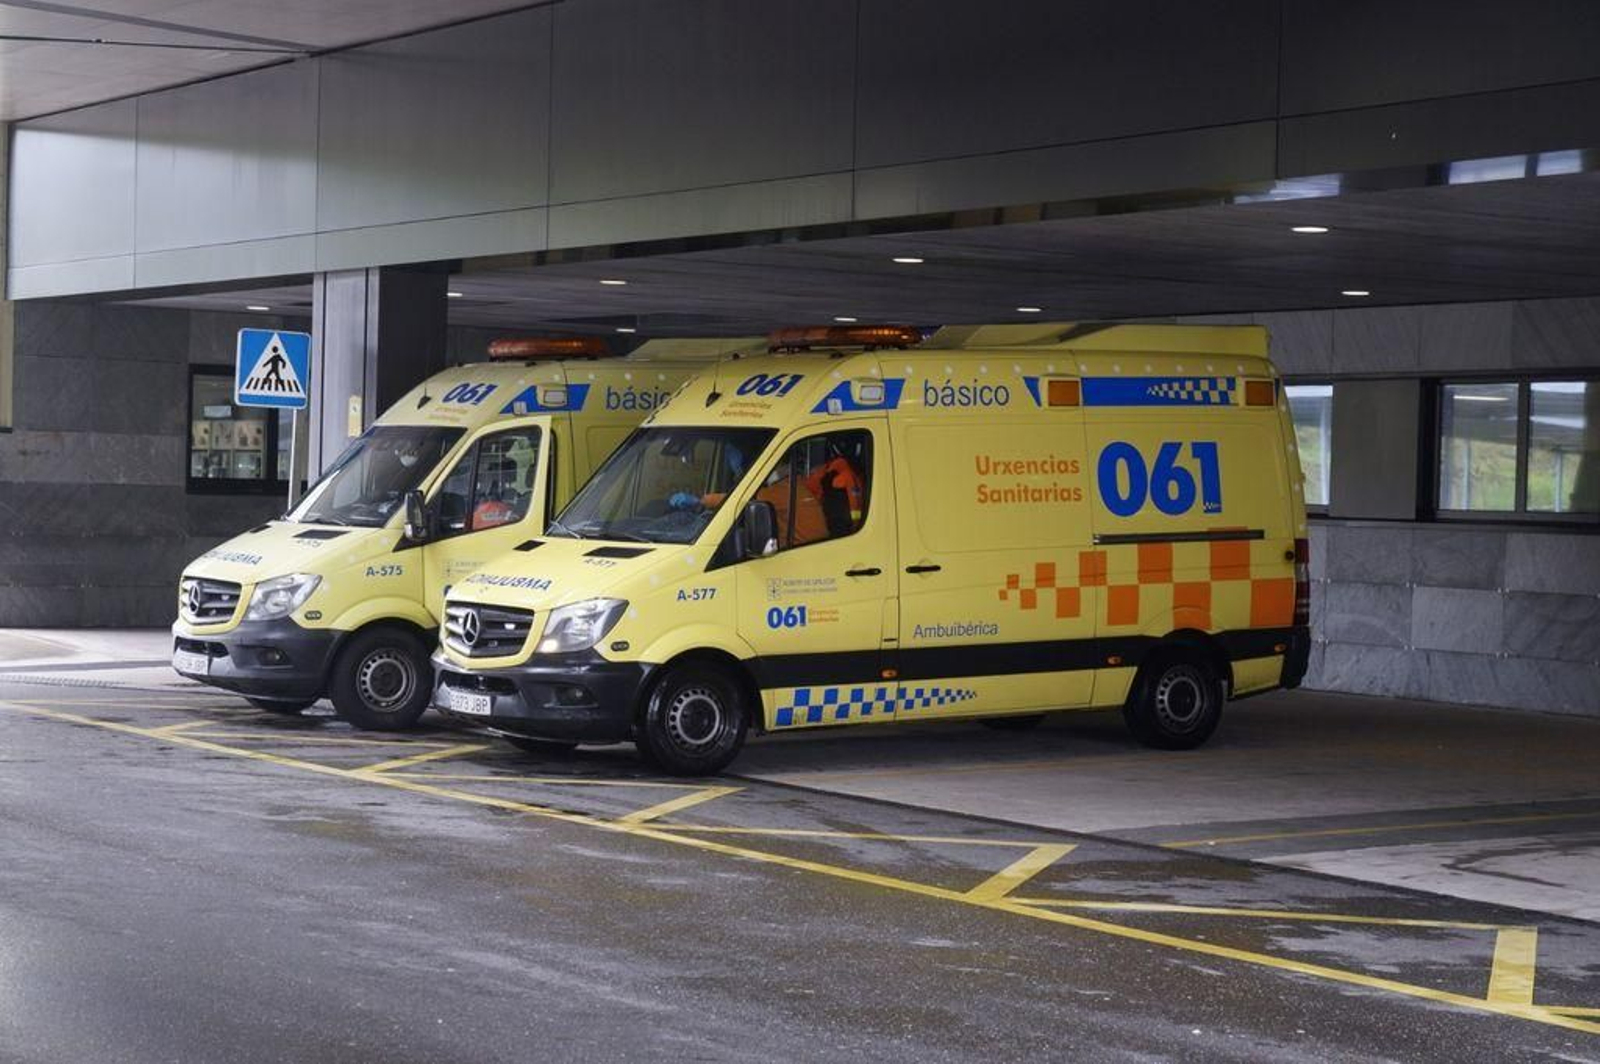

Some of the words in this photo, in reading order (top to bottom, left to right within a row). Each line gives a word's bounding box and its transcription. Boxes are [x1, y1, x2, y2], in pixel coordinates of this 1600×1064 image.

[442, 383, 498, 405] 061
[737, 374, 805, 397] 061
[924, 379, 1010, 406] básico
[605, 384, 672, 410] básic
[975, 455, 1080, 475] Urxencias
[1097, 442, 1222, 516] 061
[976, 483, 1082, 504] Sanitarias
[366, 566, 403, 576] A-575
[677, 588, 716, 601] A-577
[767, 606, 806, 629] 061
